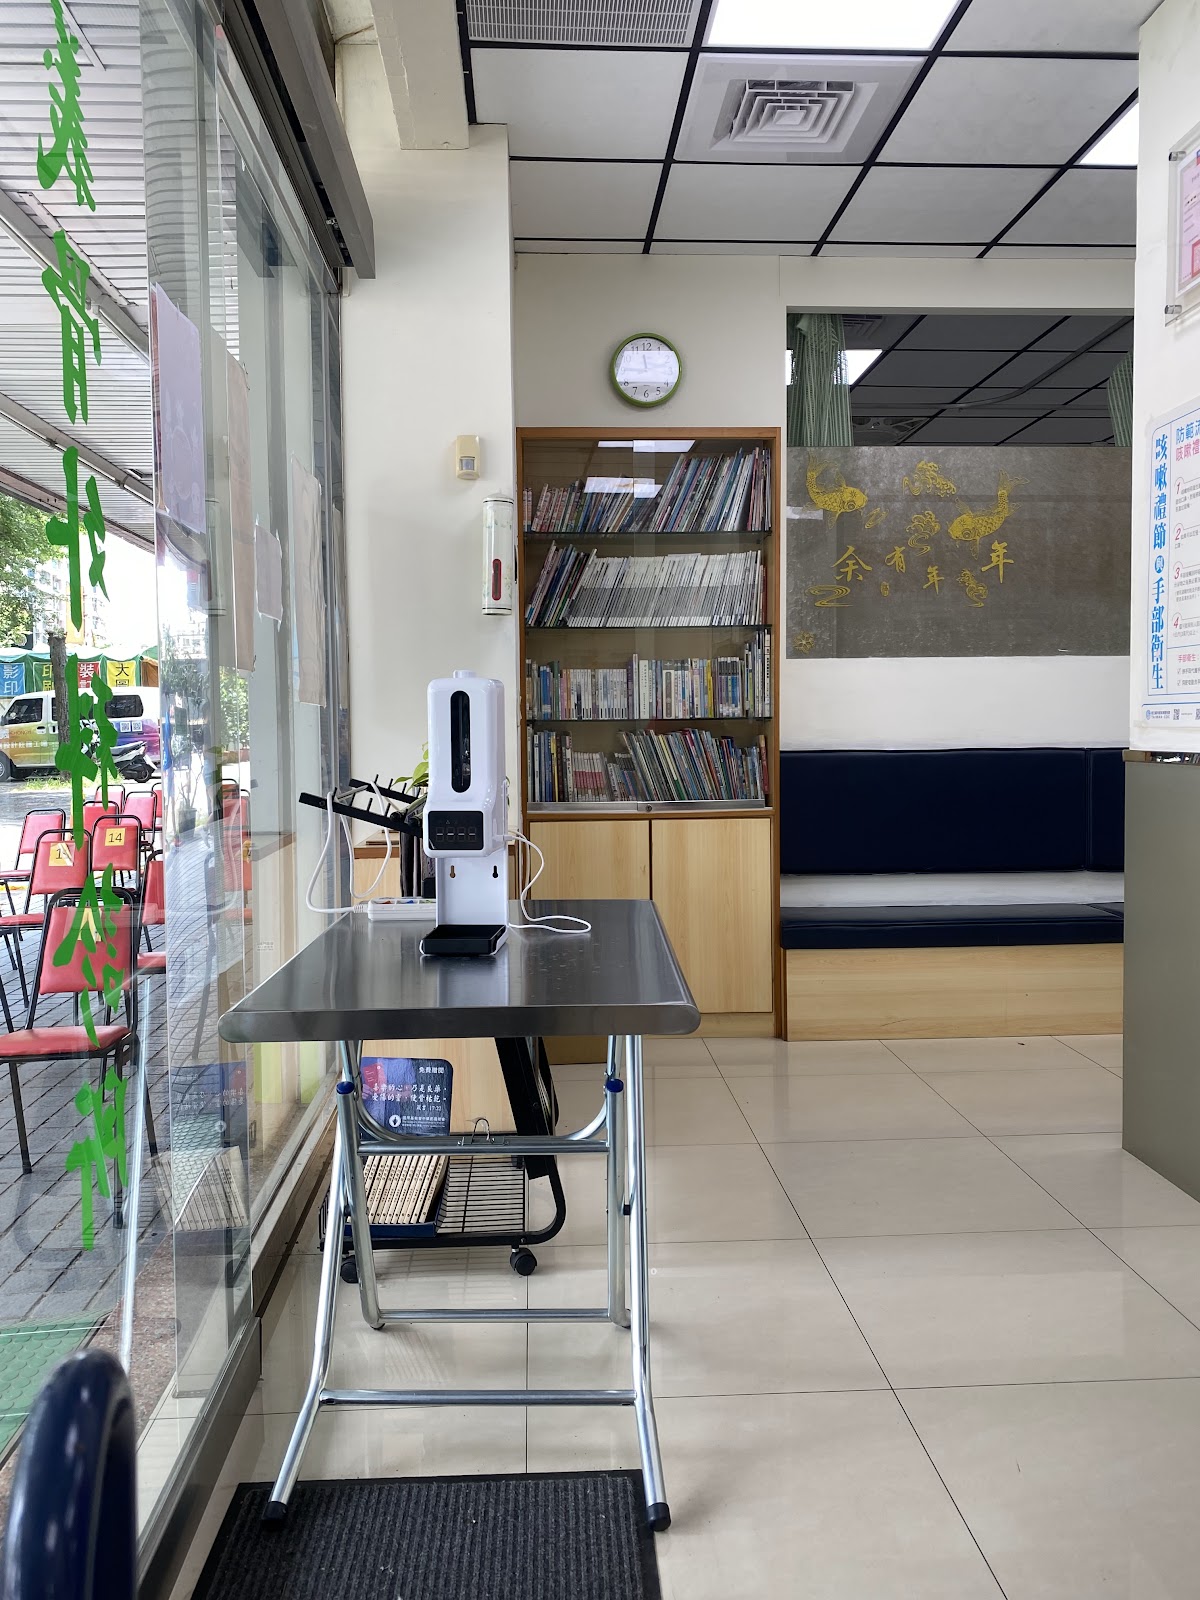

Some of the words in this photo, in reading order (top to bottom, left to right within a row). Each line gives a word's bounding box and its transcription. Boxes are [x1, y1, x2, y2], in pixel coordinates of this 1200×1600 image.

[631, 346, 639, 354] 11
[642, 343, 652, 351] 12
[632, 386, 638, 395] 7
[643, 389, 649, 398] 6
[656, 387, 661, 395] 5
[1175, 528, 1181, 541] 2
[1174, 567, 1180, 580] 3
[1173, 617, 1179, 628] 4
[3, 664, 18, 694] 影印
[108, 832, 122, 843] 14
